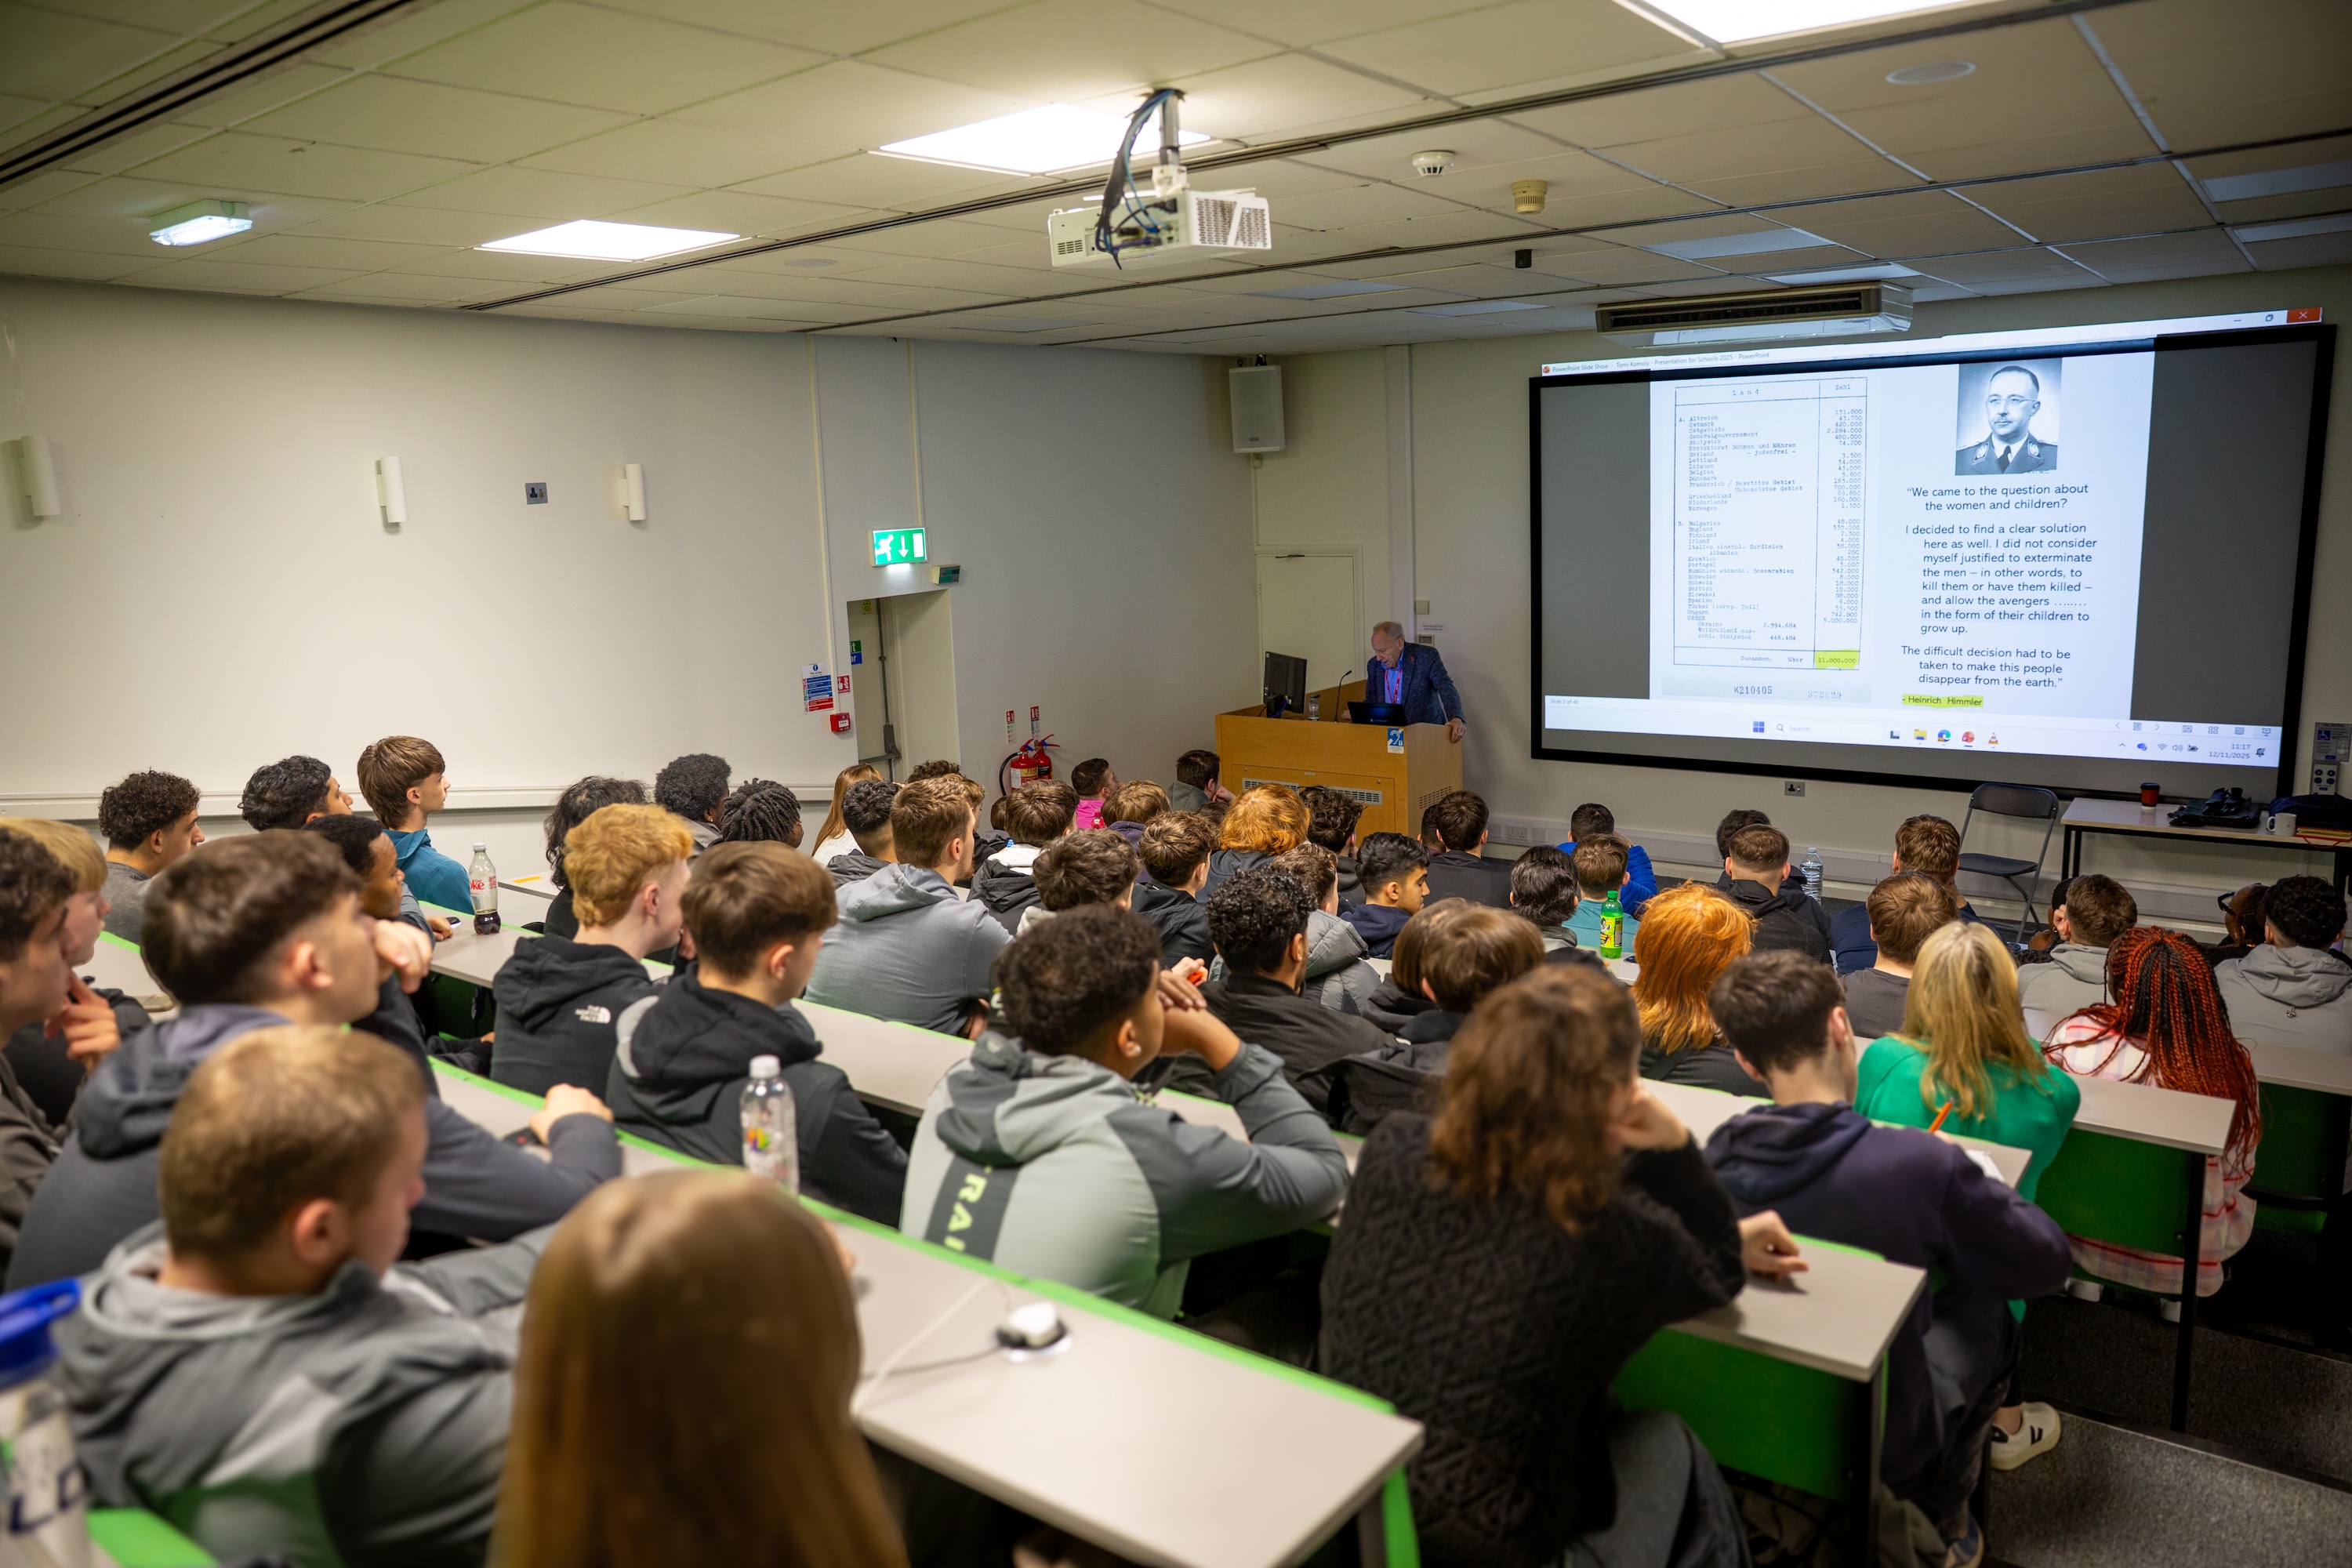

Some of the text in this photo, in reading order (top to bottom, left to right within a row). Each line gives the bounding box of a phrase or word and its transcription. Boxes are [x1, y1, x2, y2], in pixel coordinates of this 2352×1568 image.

[1907, 484, 2089, 497] “We came to the question about
[1926, 498, 2067, 510] the women and children?
[1912, 524, 1954, 534] decided
[1958, 525, 1969, 534] to
[1973, 524, 1994, 533] find
[2009, 524, 2035, 533] clear
[2039, 523, 2086, 532] solution
[1924, 539, 1947, 549] here
[1951, 539, 1963, 549] as
[1967, 539, 1991, 548] well.
[2003, 539, 2020, 548] did
[2025, 539, 2043, 548] not
[2047, 538, 2097, 548] consider
[1923, 553, 2092, 565] myself justified to exterminate
[1922, 568, 2082, 579] the men in other words, to
[1922, 582, 1937, 590] kill
[1941, 582, 1968, 591] them
[1987, 582, 2013, 591] have
[2018, 582, 2045, 591] them
[2050, 582, 2081, 591] killed
[1922, 596, 2049, 608] and allow the avengers
[1921, 610, 2089, 621] in the form of their children to
[1921, 624, 1968, 635] grow up.
[1901, 646, 2071, 659] The difficult decision had to be
[1919, 661, 2063, 675] taken to make this people
[1918, 674, 2063, 688] disappear from the earth.”
[1734, 686, 1773, 695] K210405
[1947, 697, 1983, 706] Himmler
